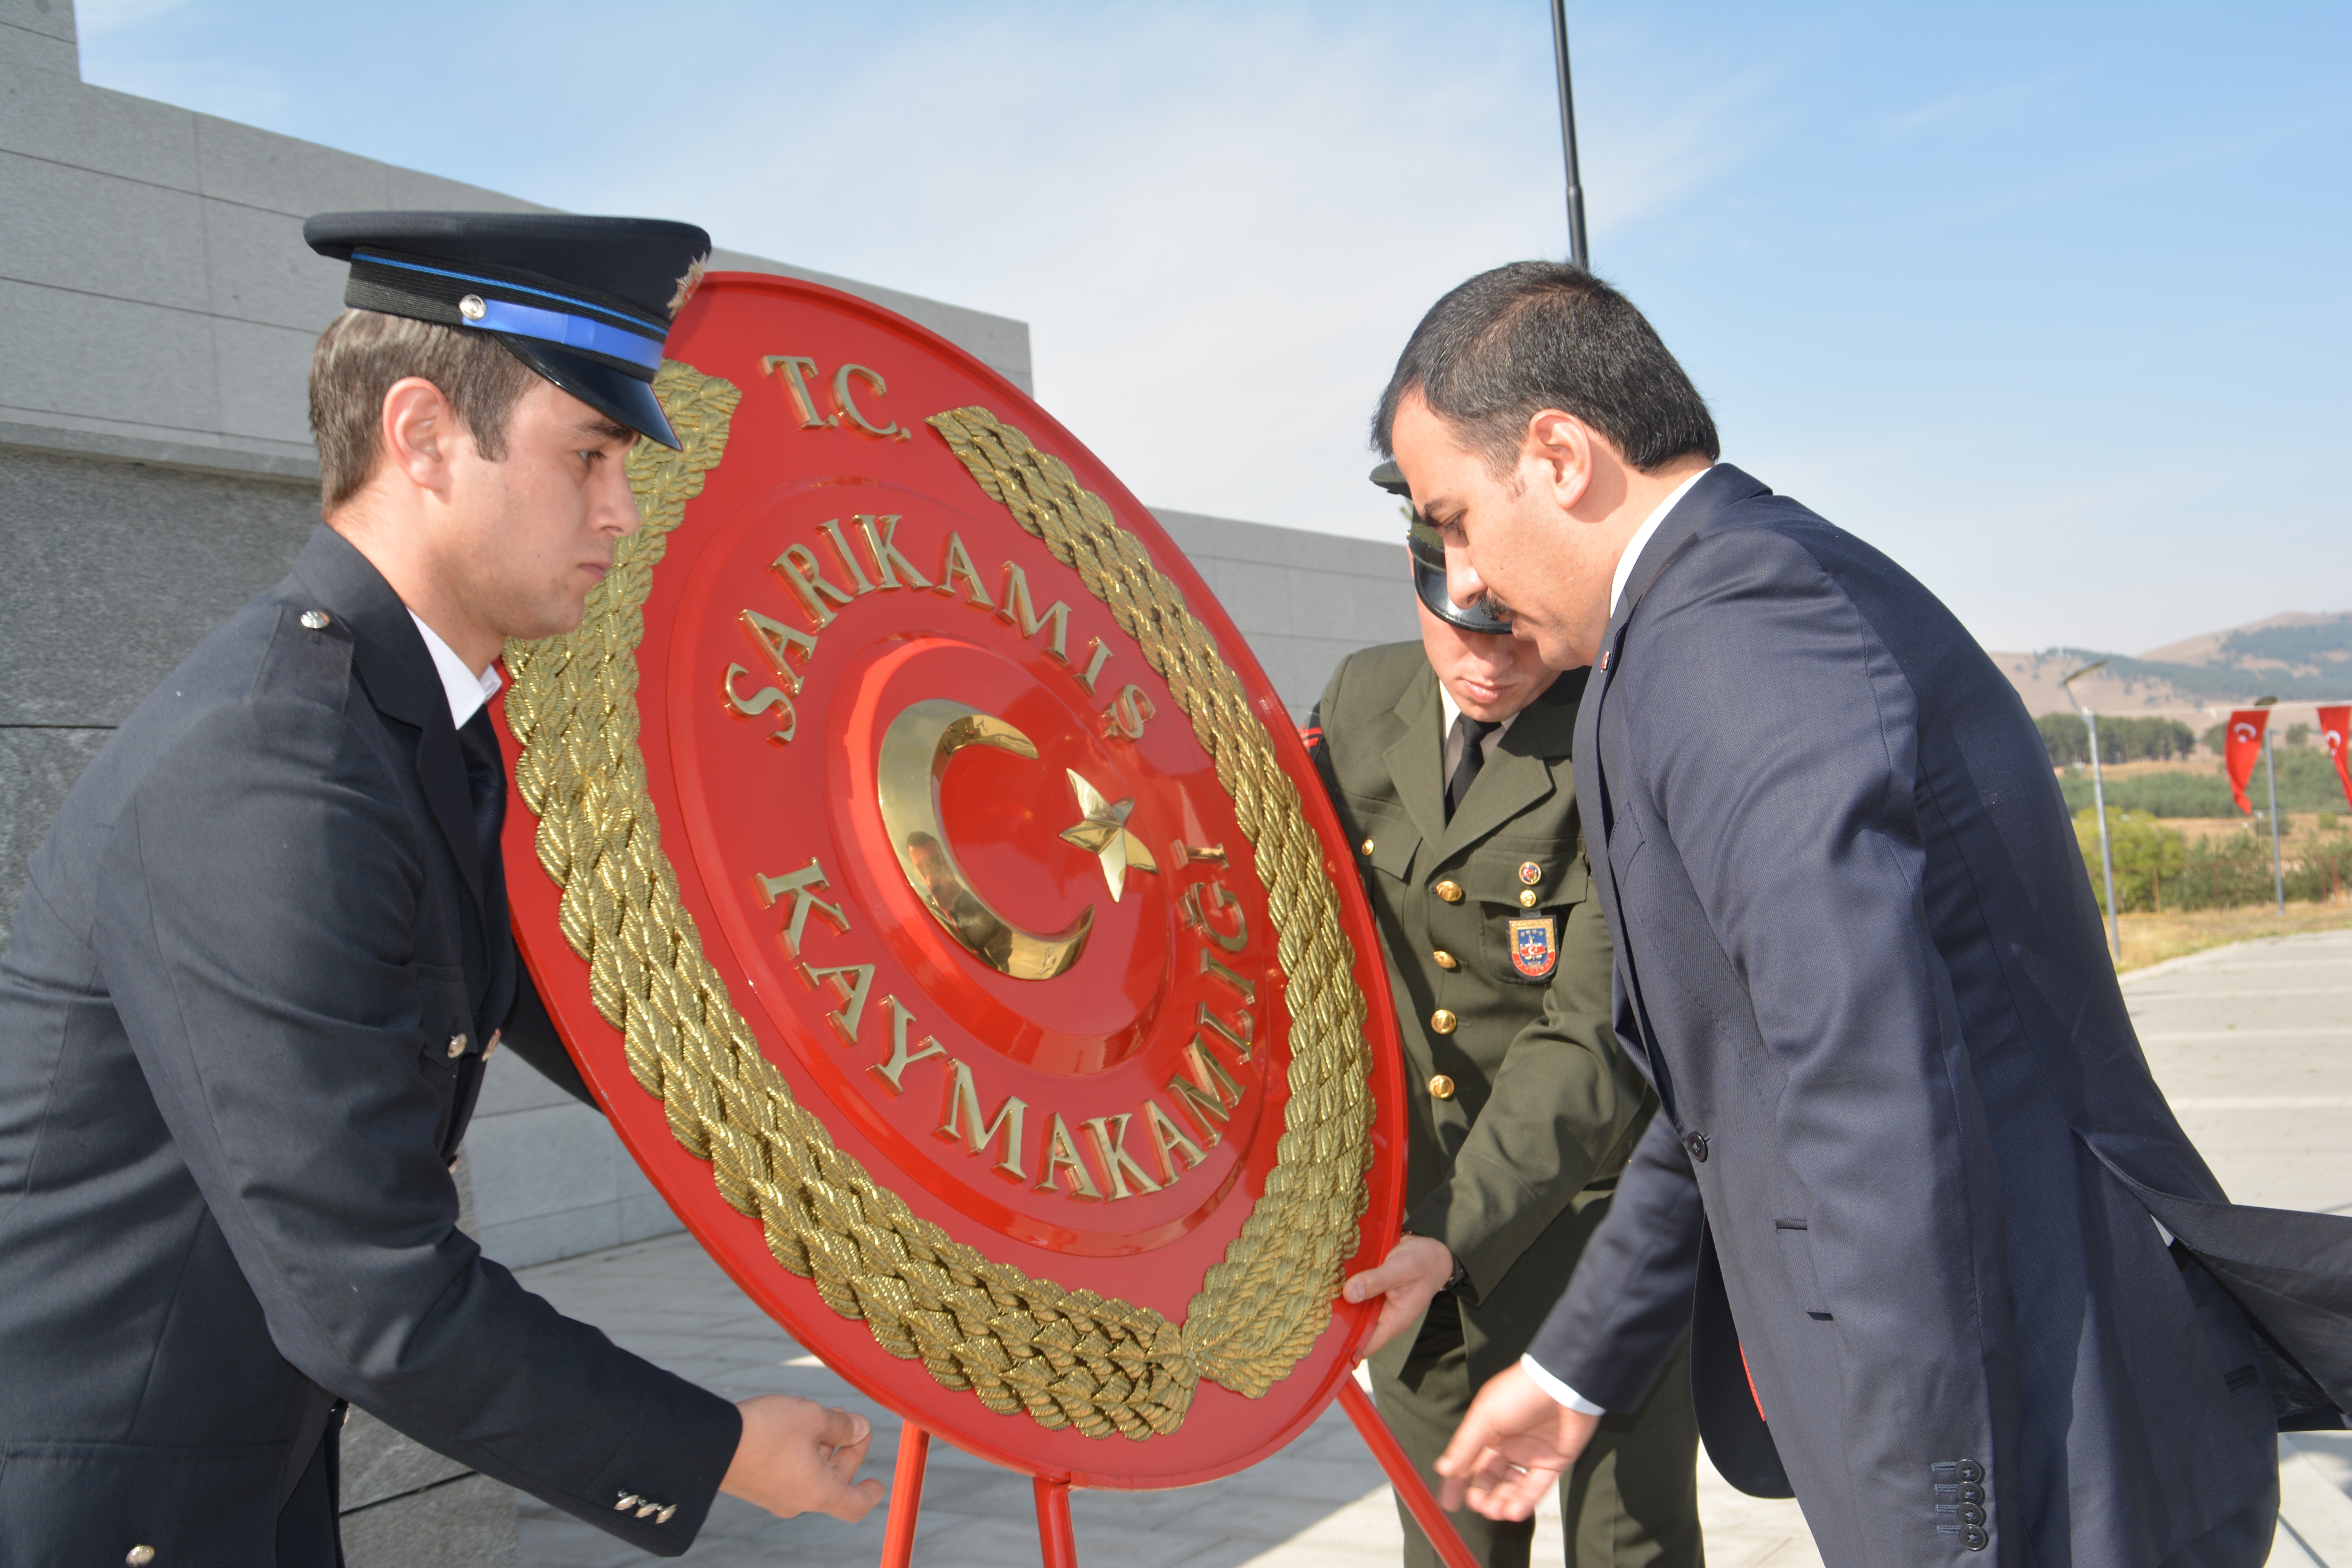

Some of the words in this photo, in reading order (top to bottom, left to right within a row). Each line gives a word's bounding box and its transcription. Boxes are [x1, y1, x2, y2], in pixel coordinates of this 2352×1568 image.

[761, 354, 911, 442] T.C.
[722, 514, 1156, 745] SARIKAMIŞ
[753, 839, 1255, 1202] KAYMAKAMLIĞI
